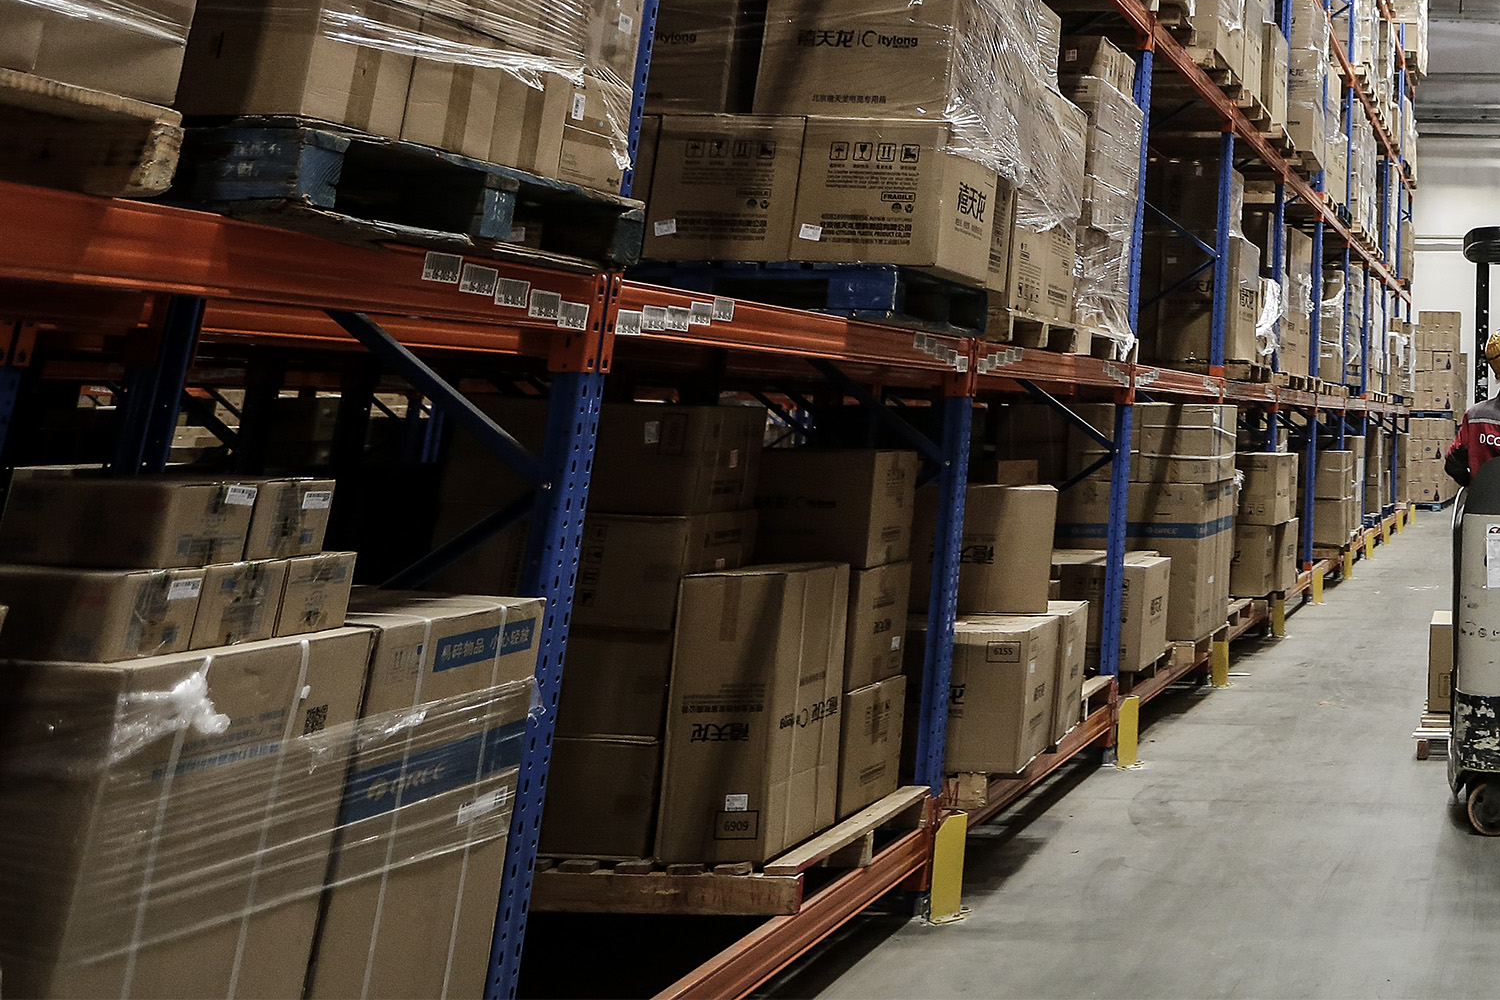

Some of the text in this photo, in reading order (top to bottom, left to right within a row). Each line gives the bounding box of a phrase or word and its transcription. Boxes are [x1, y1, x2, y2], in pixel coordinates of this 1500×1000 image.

[654, 31, 697, 44] itylong
[797, 29, 855, 48] 禧天龙
[957, 181, 987, 223] 禧天龙
[993, 648, 1013, 656] 6155
[691, 722, 750, 743] 禧天龙
